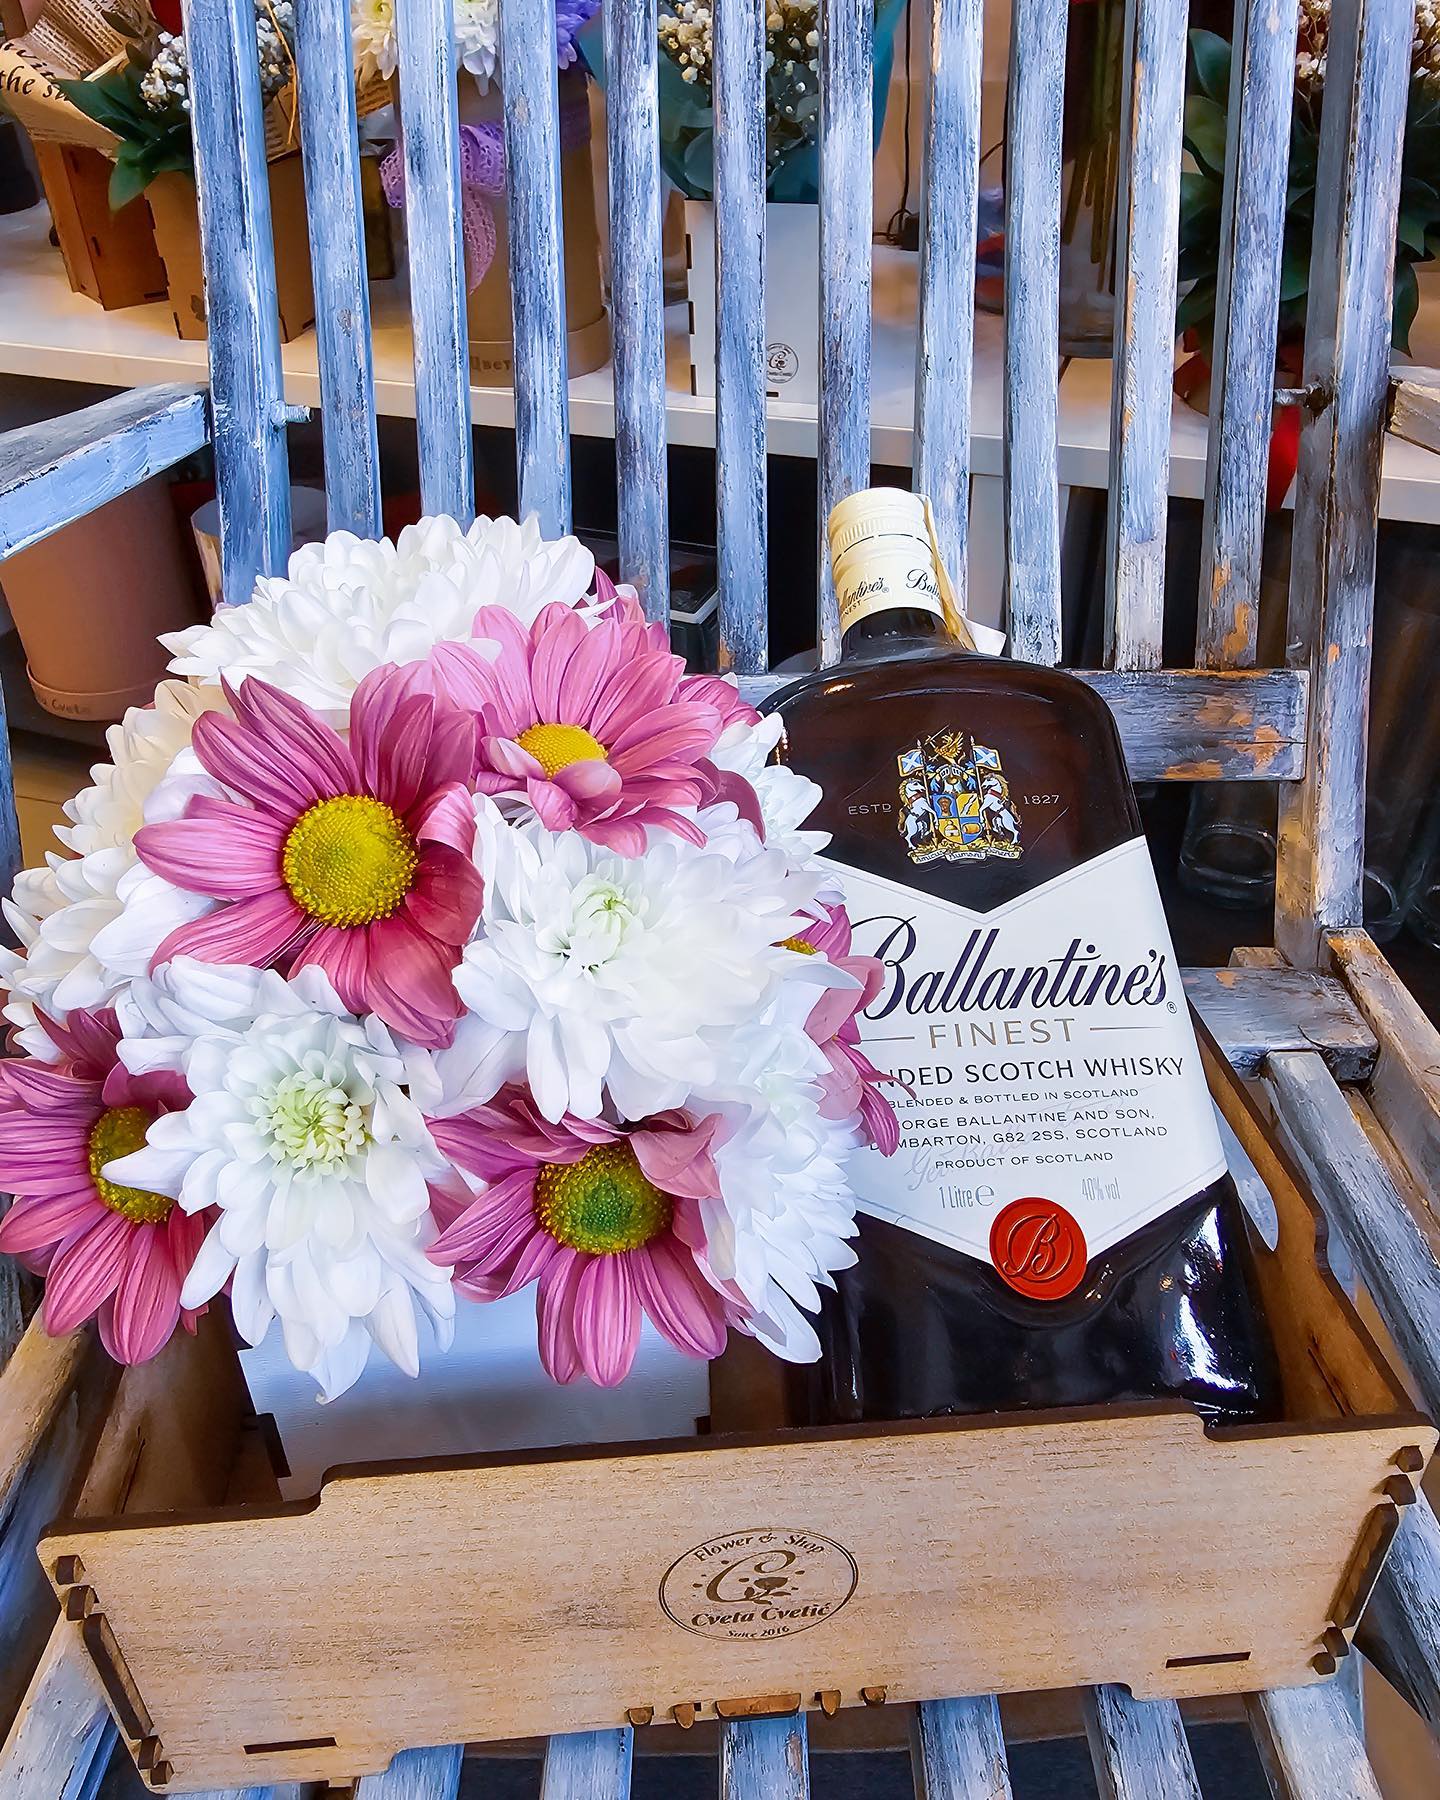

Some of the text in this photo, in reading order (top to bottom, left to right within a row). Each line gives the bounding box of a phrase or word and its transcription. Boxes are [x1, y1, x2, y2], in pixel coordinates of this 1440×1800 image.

[848, 794, 1060, 815] ESTD 1827
[928, 1017, 1076, 1049] FINEST
[964, 1059, 1074, 1083] SCOTCH
[1083, 1057, 1183, 1077] WHISKY
[888, 1088, 1139, 1109] BLENDED & BOTTLED IN SCOTLAND
[956, 1111, 1068, 1127] BALLANTINE
[1073, 1109, 1109, 1121] AND
[1115, 1108, 1156, 1120] SON,
[993, 1131, 1025, 1144] G82
[1032, 1129, 1069, 1142] 2SS,
[1075, 1126, 1168, 1140] SCOTLAND
[935, 1151, 1114, 1170] PRODUCT OF SCOTLAND
[948, 1185, 974, 1209] Litre
[1082, 1176, 1121, 1201] 40% vol
[692, 1532, 825, 1562] Flower & Shop
[691, 1611, 755, 1627] Cveta
[760, 1625, 790, 1637] 2016
